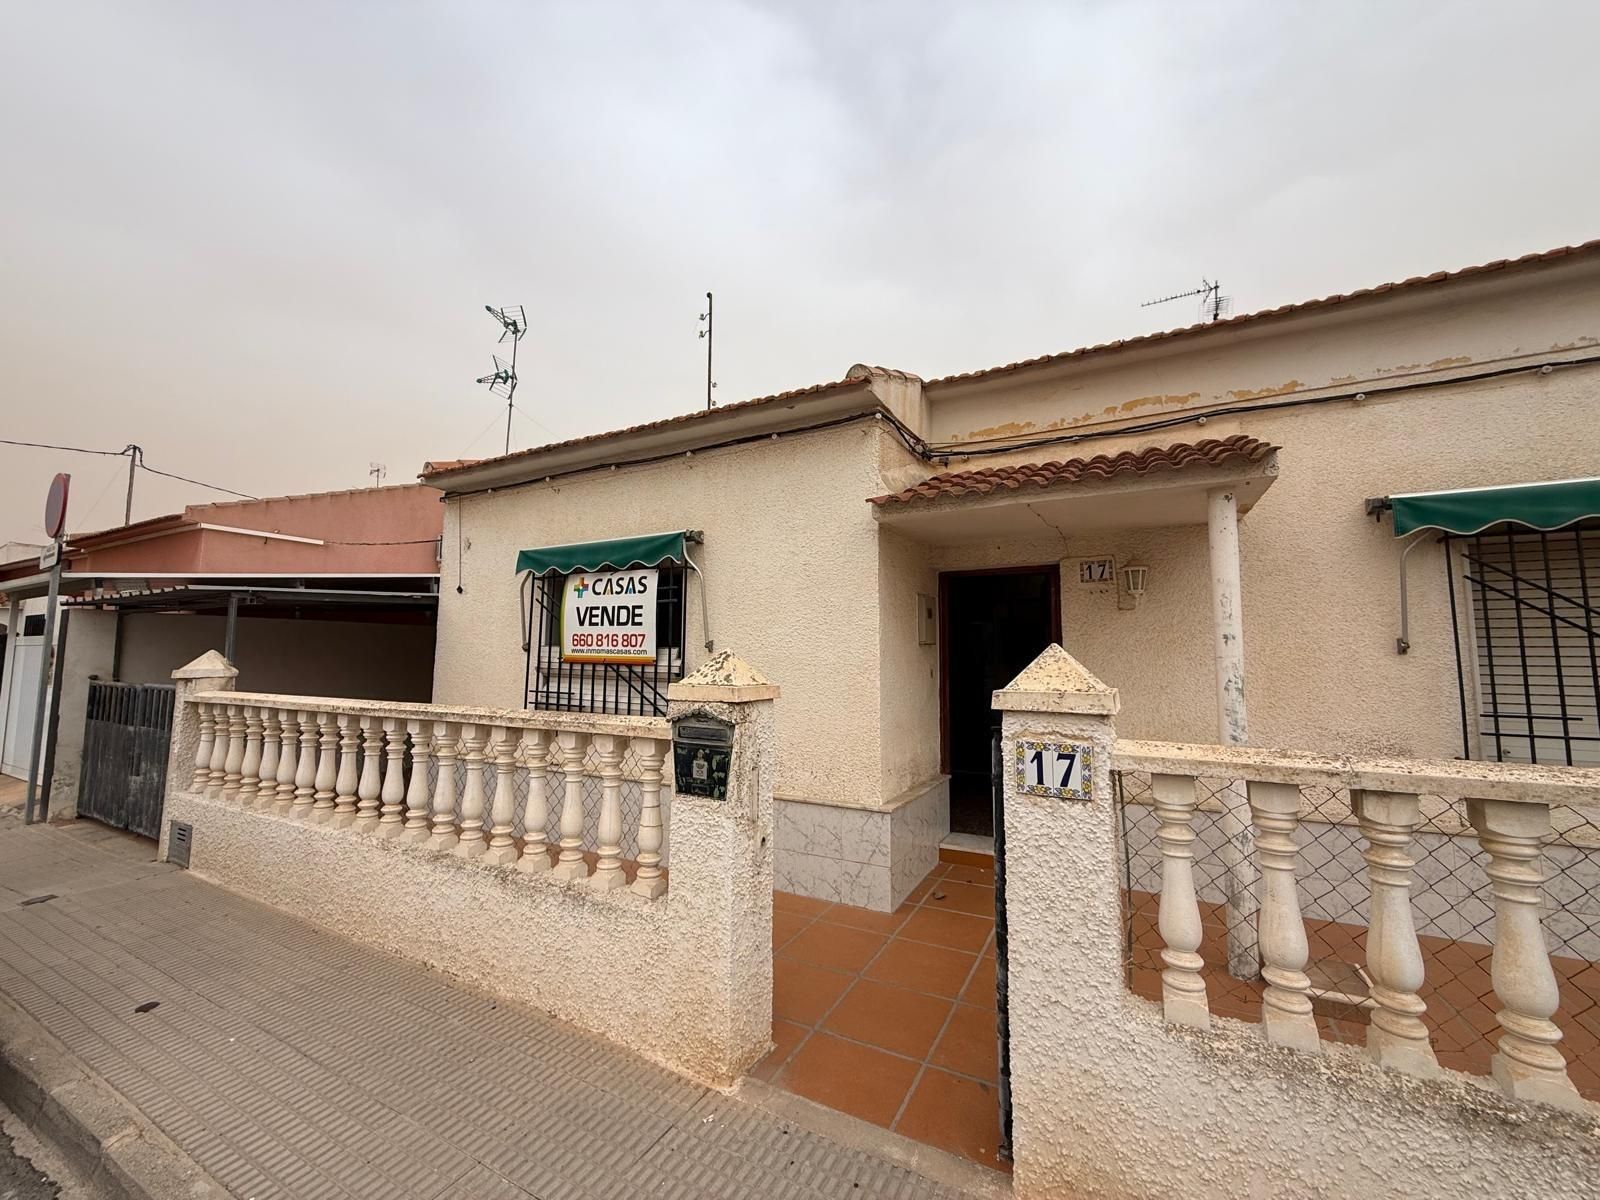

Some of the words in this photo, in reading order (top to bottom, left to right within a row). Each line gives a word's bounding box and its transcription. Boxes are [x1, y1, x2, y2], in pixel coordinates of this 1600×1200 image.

[1086, 564, 1107, 579] 17
[592, 576, 648, 595] CASAS
[576, 605, 644, 627] VENDE
[572, 633, 594, 647] 660
[596, 634, 619, 647] 816
[621, 634, 646, 648] 807
[1030, 751, 1076, 787] 17
